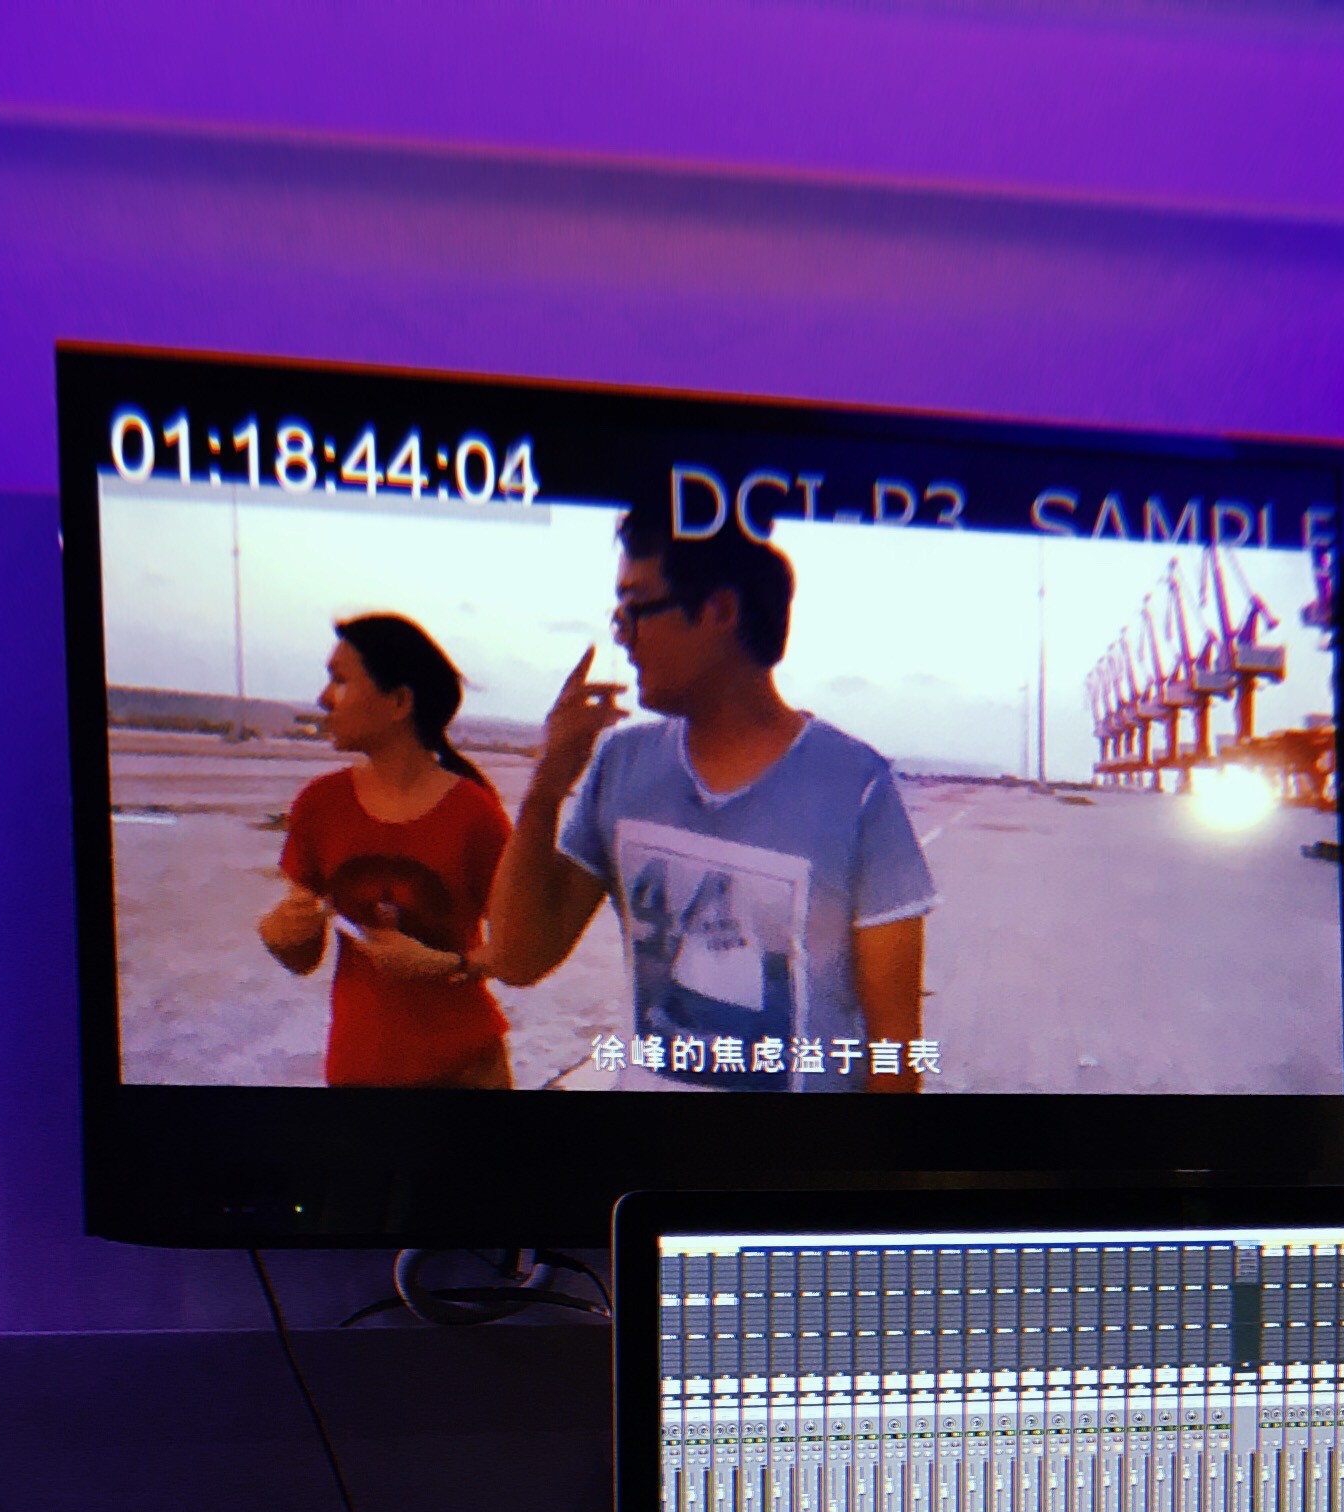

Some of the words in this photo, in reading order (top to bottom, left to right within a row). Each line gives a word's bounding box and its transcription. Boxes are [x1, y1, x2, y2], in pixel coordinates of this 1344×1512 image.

[110, 405, 540, 507] 01:18:44:04
[590, 1034, 942, 1075] 徐峰的焦虑溢于言表
